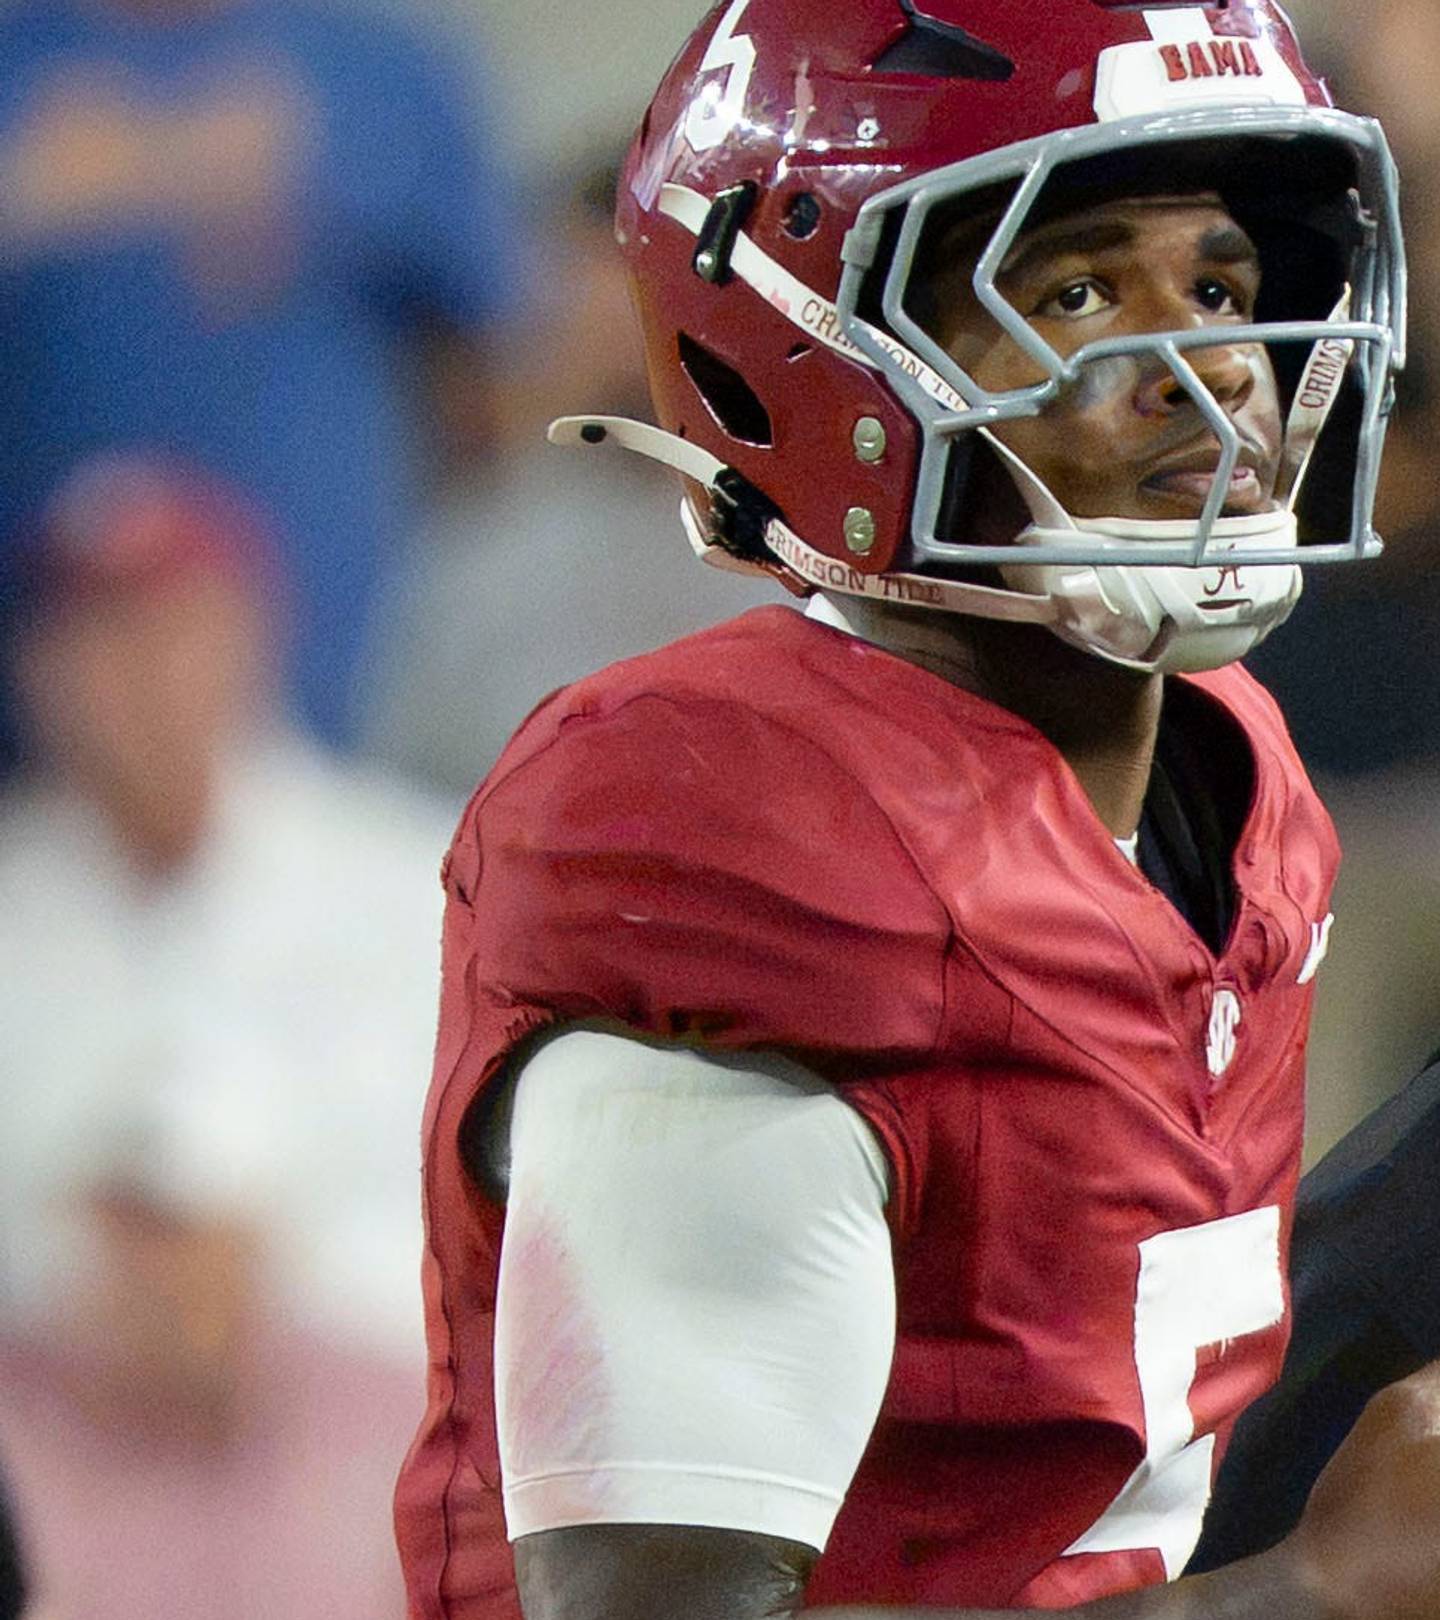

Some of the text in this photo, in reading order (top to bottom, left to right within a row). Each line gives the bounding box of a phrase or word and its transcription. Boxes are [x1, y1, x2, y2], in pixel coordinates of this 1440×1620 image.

[1159, 41, 1263, 81] BAMA
[879, 573, 943, 604] TIDE
[1061, 1205, 1285, 1583] 5
